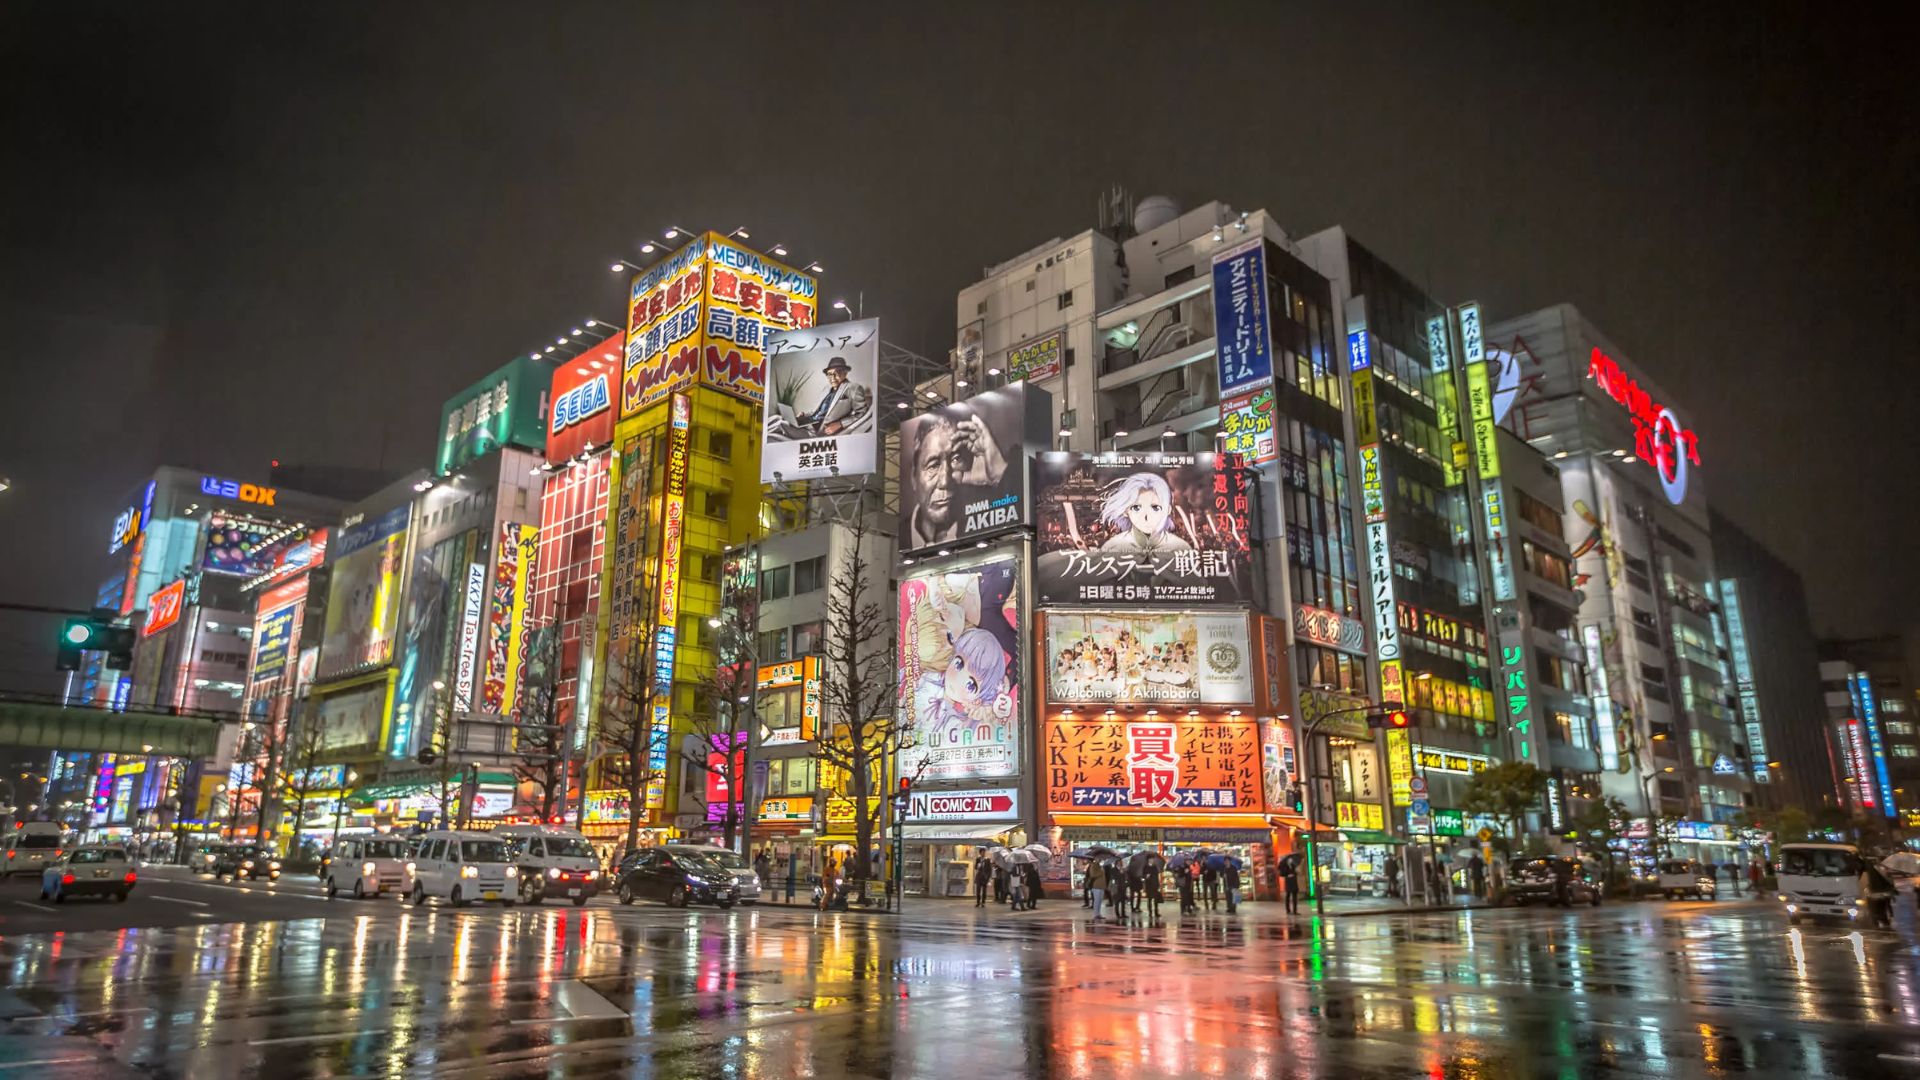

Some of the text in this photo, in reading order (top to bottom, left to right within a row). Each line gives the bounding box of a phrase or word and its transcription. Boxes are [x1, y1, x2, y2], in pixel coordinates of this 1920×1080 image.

[553, 375, 609, 431] SEGA
[1223, 412, 1272, 434] まんが
[798, 453, 838, 468] 英会話
[799, 439, 838, 454] DMM
[964, 504, 1019, 533] AKIBA
[1058, 549, 1231, 581] アルスラーン戦記
[1153, 585, 1216, 595] TVアニメ放送中
[1054, 686, 1199, 699] Welcome to Akihabara
[1503, 646, 1531, 758] リバティー
[1072, 725, 1088, 784] アイドル
[1089, 725, 1104, 768] アニメ
[1106, 725, 1125, 786] 美少女系
[1130, 726, 1176, 804] 買取
[1181, 726, 1199, 787] フィギュア
[1199, 726, 1215, 770] ホビー
[1217, 726, 1236, 789] 携帯電話
[1236, 726, 1257, 808] アップルとか
[931, 799, 972, 812] COMIC
[974, 797, 992, 811] ZIN
[1074, 790, 1235, 806] チケット 大黒屋
